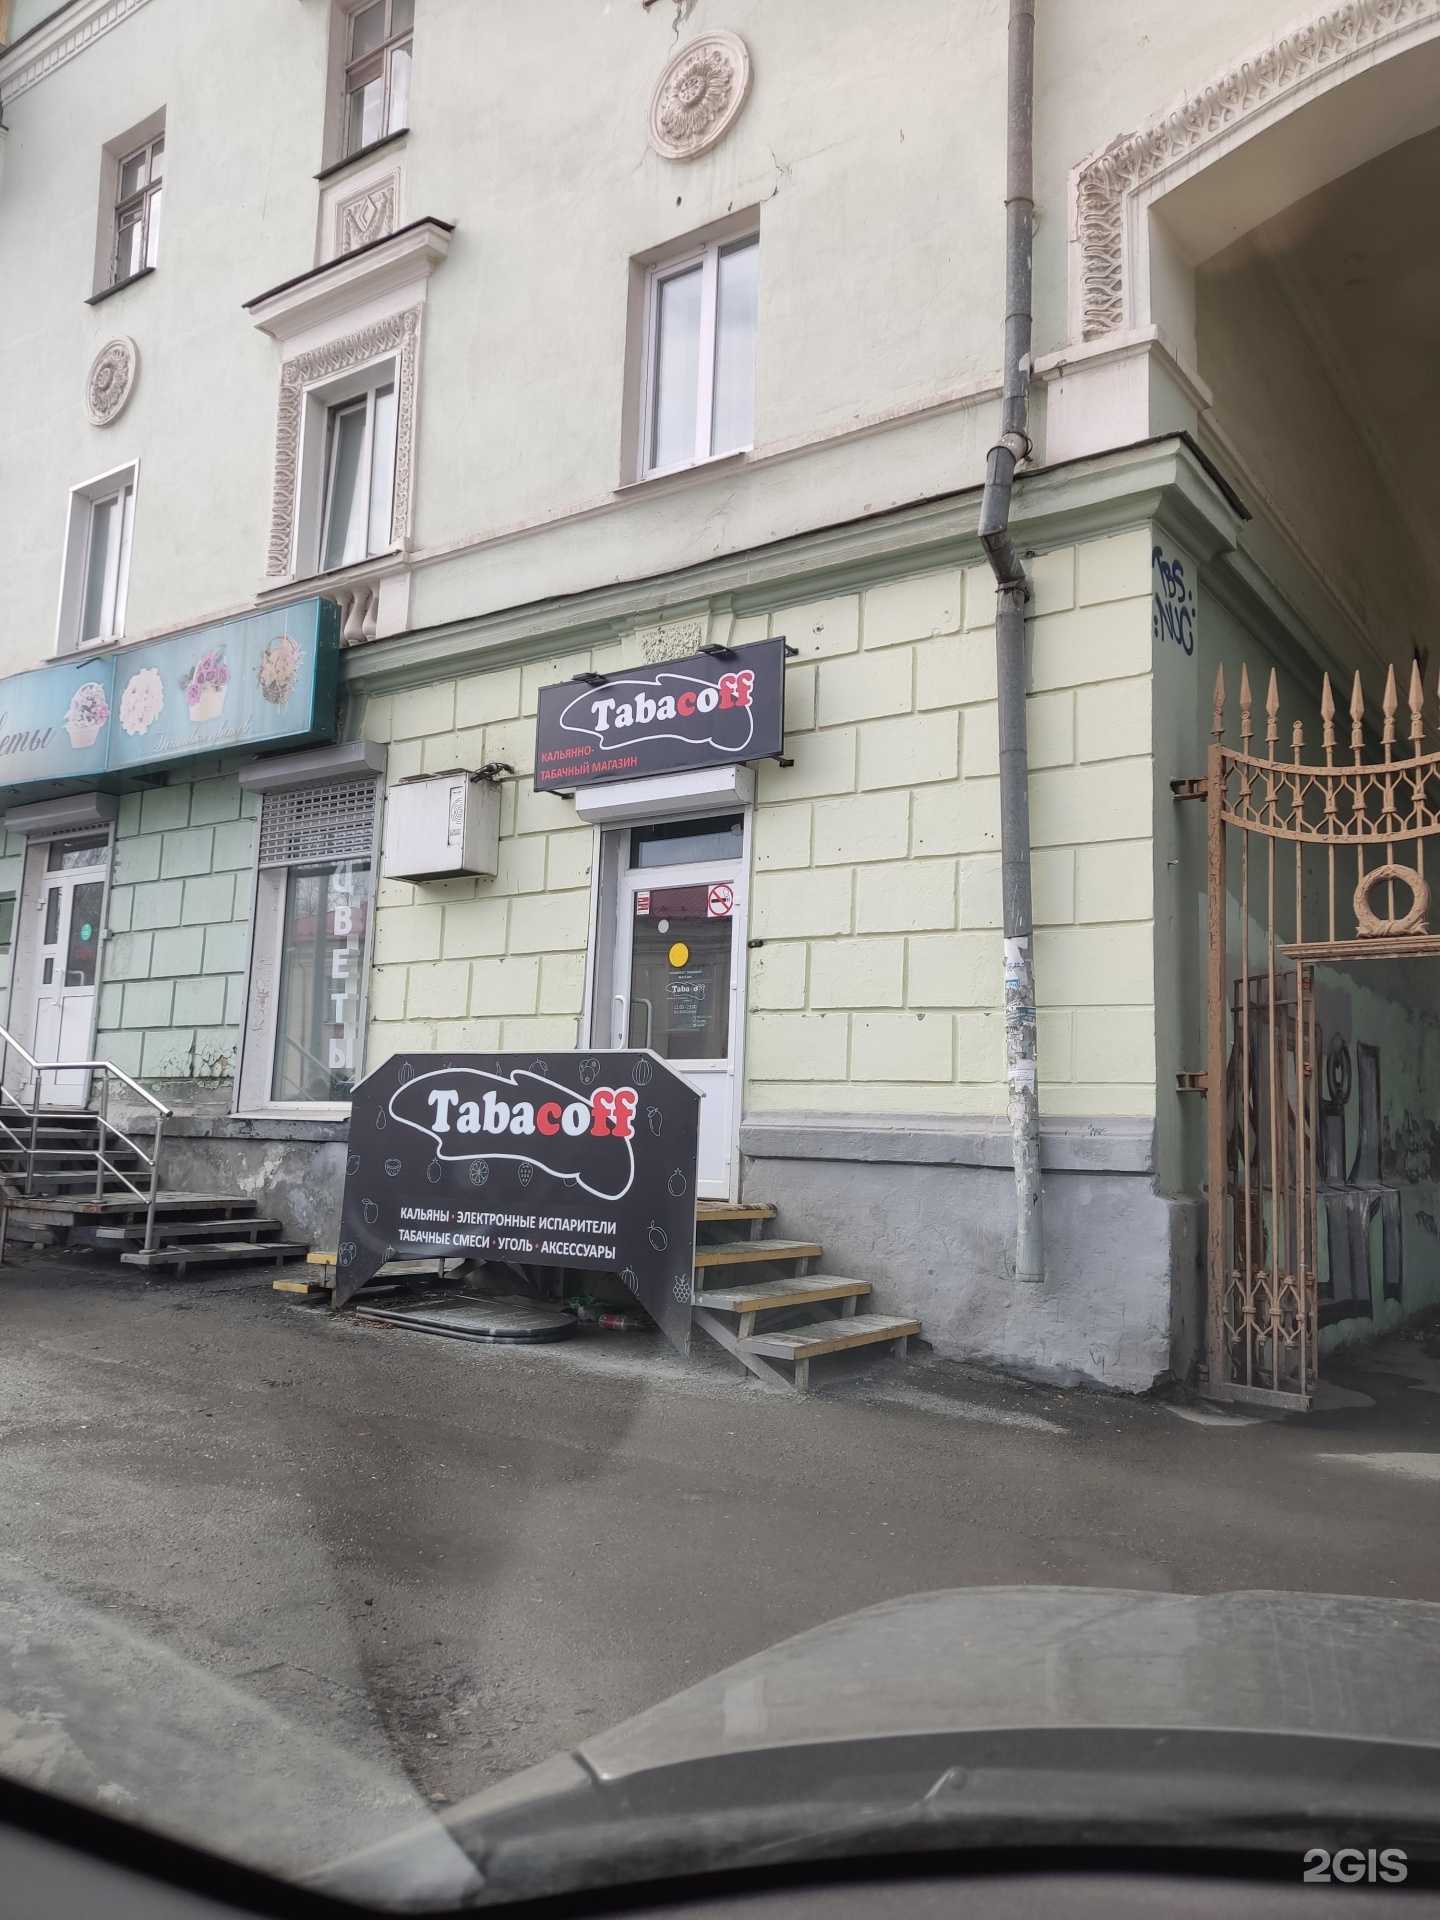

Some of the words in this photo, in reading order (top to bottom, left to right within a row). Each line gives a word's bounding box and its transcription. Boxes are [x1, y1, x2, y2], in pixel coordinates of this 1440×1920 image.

[590, 669, 755, 732] Tabacoff
[541, 761, 590, 781] ТАБАЧНЫЙ
[591, 756, 638, 773] МАГАЗИН
[428, 1087, 639, 1140] Tabacoff
[400, 1207, 449, 1223] КАЛЬЯНЫ
[456, 1211, 536, 1229] ЭЛЕКТРОННЫЕ
[538, 1217, 617, 1235] ИСПАРИТЕЛИ
[398, 1229, 450, 1245] ТАБАЧНЫЕ
[452, 1234, 490, 1249] СМЕСИ
[498, 1236, 533, 1252] УГОЛЬ
[540, 1241, 616, 1260] АКСЕССУАРЫ
